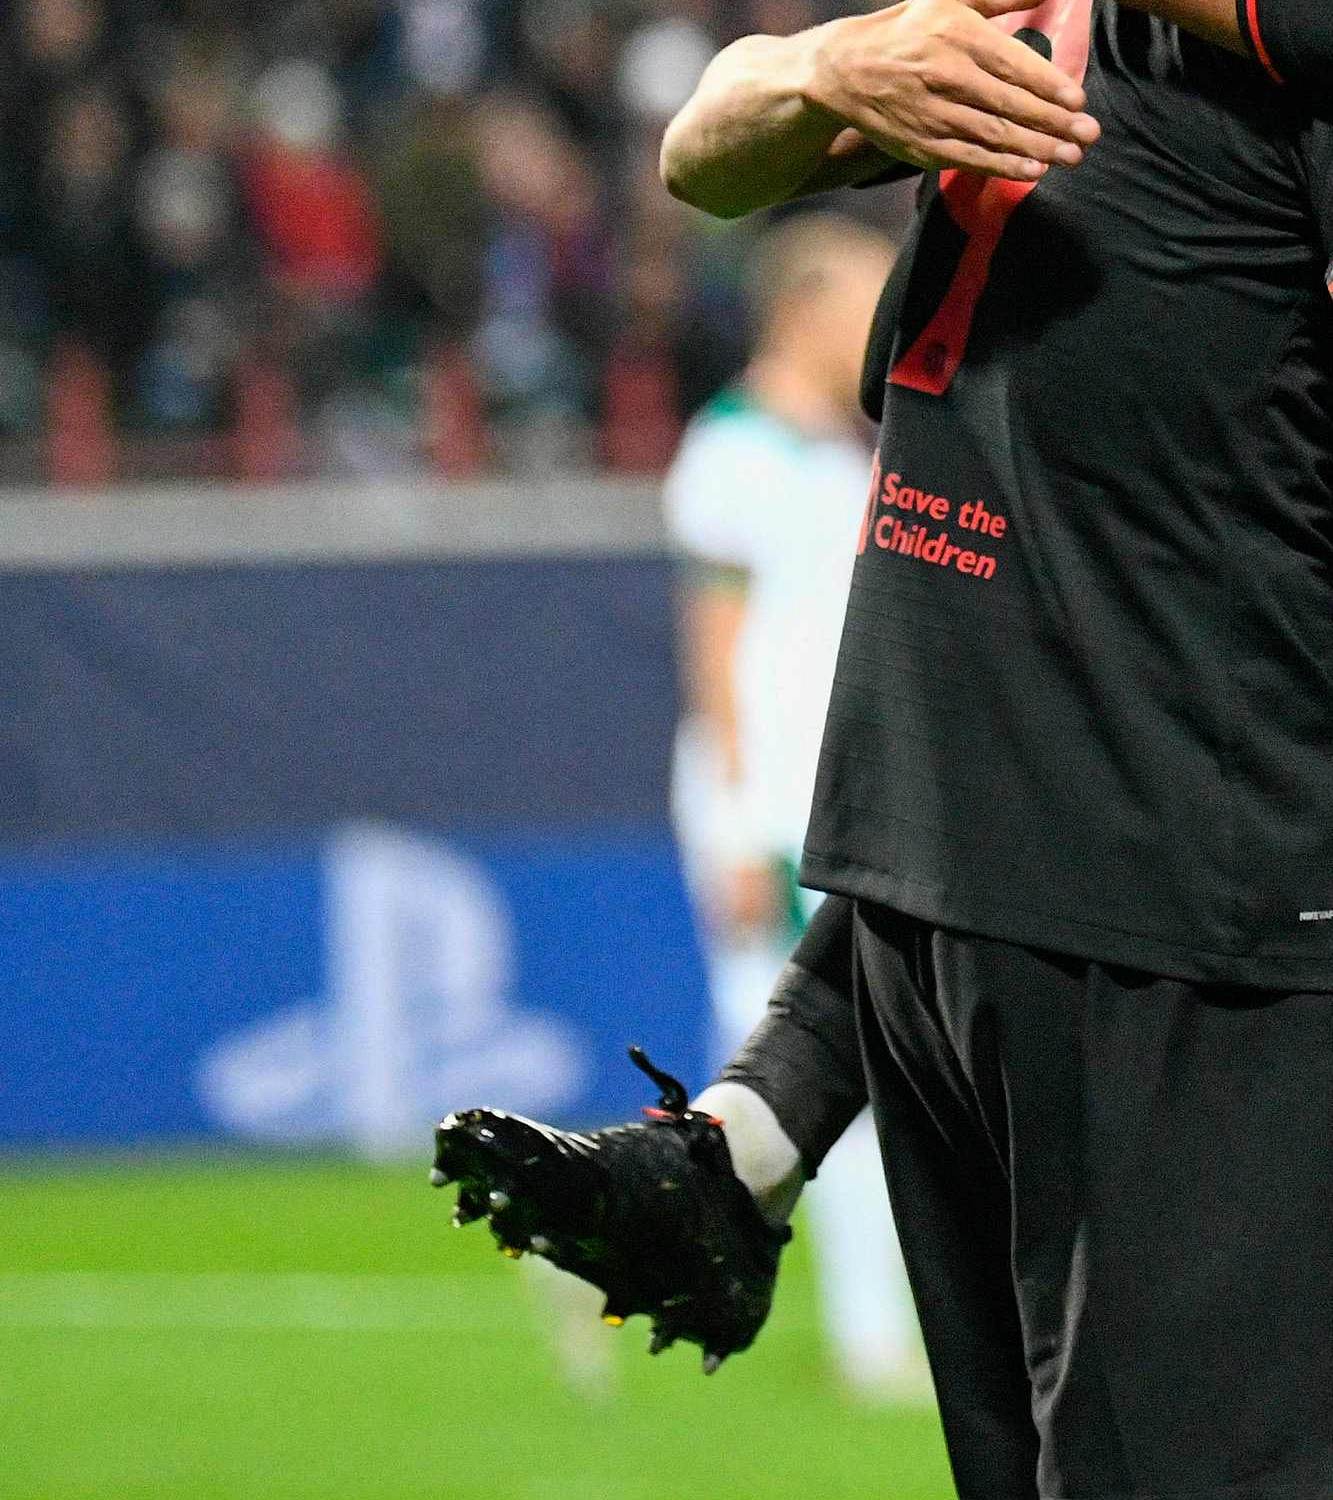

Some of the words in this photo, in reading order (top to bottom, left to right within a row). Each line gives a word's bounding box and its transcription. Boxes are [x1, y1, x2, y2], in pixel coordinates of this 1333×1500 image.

[881, 472, 950, 520] Save
[958, 500, 1008, 539] the
[874, 515, 998, 581] Children
